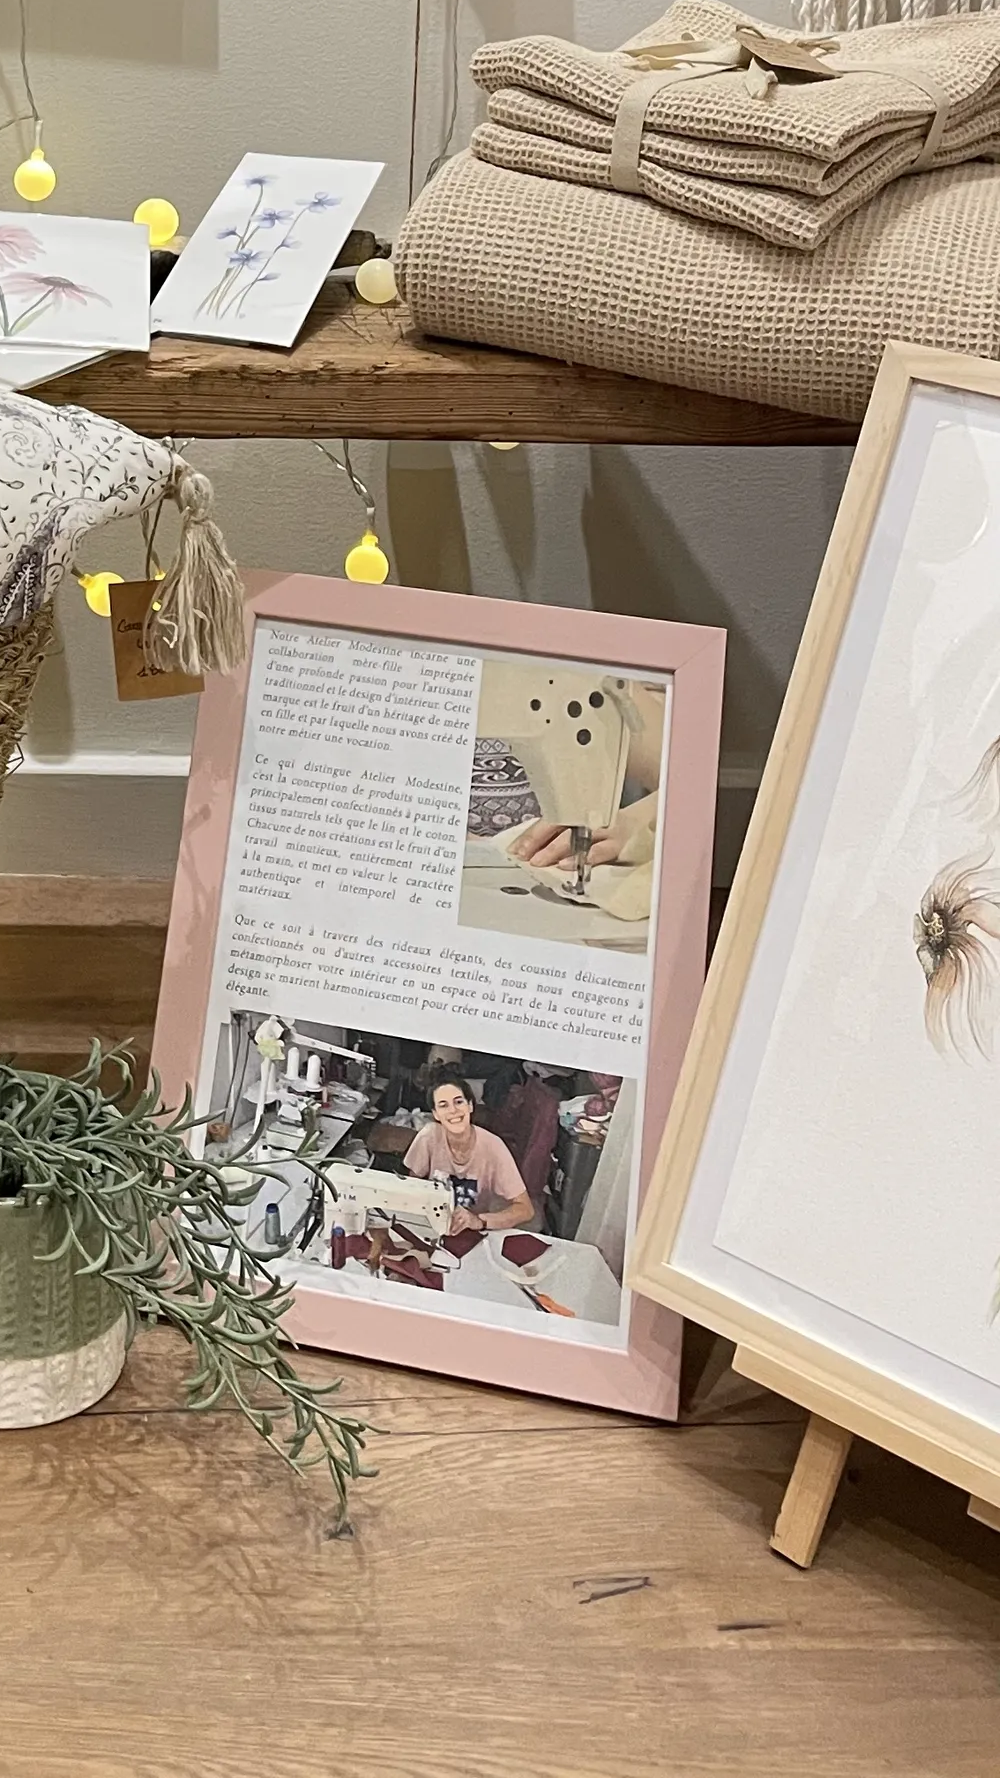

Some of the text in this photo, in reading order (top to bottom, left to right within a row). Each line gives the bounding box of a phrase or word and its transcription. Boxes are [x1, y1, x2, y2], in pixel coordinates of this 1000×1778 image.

[268, 646, 475, 682] collaboration mère-fille imprégnée
[270, 629, 477, 666] Notre Atelier Modestine incarne une
[264, 677, 325, 693] traditionnel
[326, 686, 336, 695] et
[337, 685, 348, 696] le
[348, 687, 382, 703] design
[443, 701, 472, 713] Cette
[266, 660, 473, 698] d'une profonde passion pour l'artisanat
[260, 708, 469, 746] en fille et par laquelle nous avons créé de
[262, 693, 470, 729] marque est le fruit d'un héritage de mère
[258, 725, 287, 735] notre
[288, 728, 322, 741] métier
[324, 734, 344, 744] une
[252, 771, 274, 782] c'est
[277, 772, 287, 784] la
[291, 778, 348, 793] conception
[352, 784, 365, 795] de
[367, 789, 413, 803] produits
[255, 753, 463, 795] Ce qui distingue Atelier Modestine,
[248, 802, 277, 815] tissus
[280, 809, 322, 821] naturels
[324, 813, 343, 825] tels
[346, 819, 366, 830] que
[368, 819, 378, 831] le
[381, 820, 396, 833] lin
[399, 826, 410, 835] et
[412, 826, 422, 837] le
[249, 787, 461, 826] principalement confectionnés à partir de
[244, 835, 278, 848] travail
[349, 853, 413, 869] entièrement
[420, 862, 456, 875] réalisé
[247, 817, 457, 859] Chacune de nos créations est le fruit d'un
[240, 867, 452, 909] authentique et intemporel de ces
[242, 849, 248, 860] à
[251, 850, 261, 862] la
[298, 860, 308, 869] et
[311, 863, 332, 873] met
[335, 867, 348, 875] en
[352, 867, 385, 882] valeur
[388, 871, 398, 884] le
[405, 878, 454, 892] caractère
[231, 932, 304, 951] confectionnés
[312, 946, 326, 956] ou
[333, 947, 375, 964] d'autres
[383, 958, 442, 975] accessoires
[450, 968, 492, 984] textiles,
[501, 978, 528, 989] nous
[536, 984, 563, 995] nous
[571, 990, 630, 1007] engageons
[234, 913, 256, 927] Que
[263, 921, 275, 930] ce
[282, 924, 302, 934] soit
[322, 929, 359, 944] travers
[365, 935, 384, 948] des
[391, 941, 432, 956] rideaux
[439, 948, 486, 966] élégants,
[494, 957, 512, 969] des
[520, 964, 567, 978] coussins
[574, 970, 646, 991] délicatement
[227, 963, 642, 1044] design se marient harmonieusement pour créer une ambiance chaleureuse et
[229, 949, 643, 1026] métamorphoser votre intérieur en un espace où l'art de la couture et du
